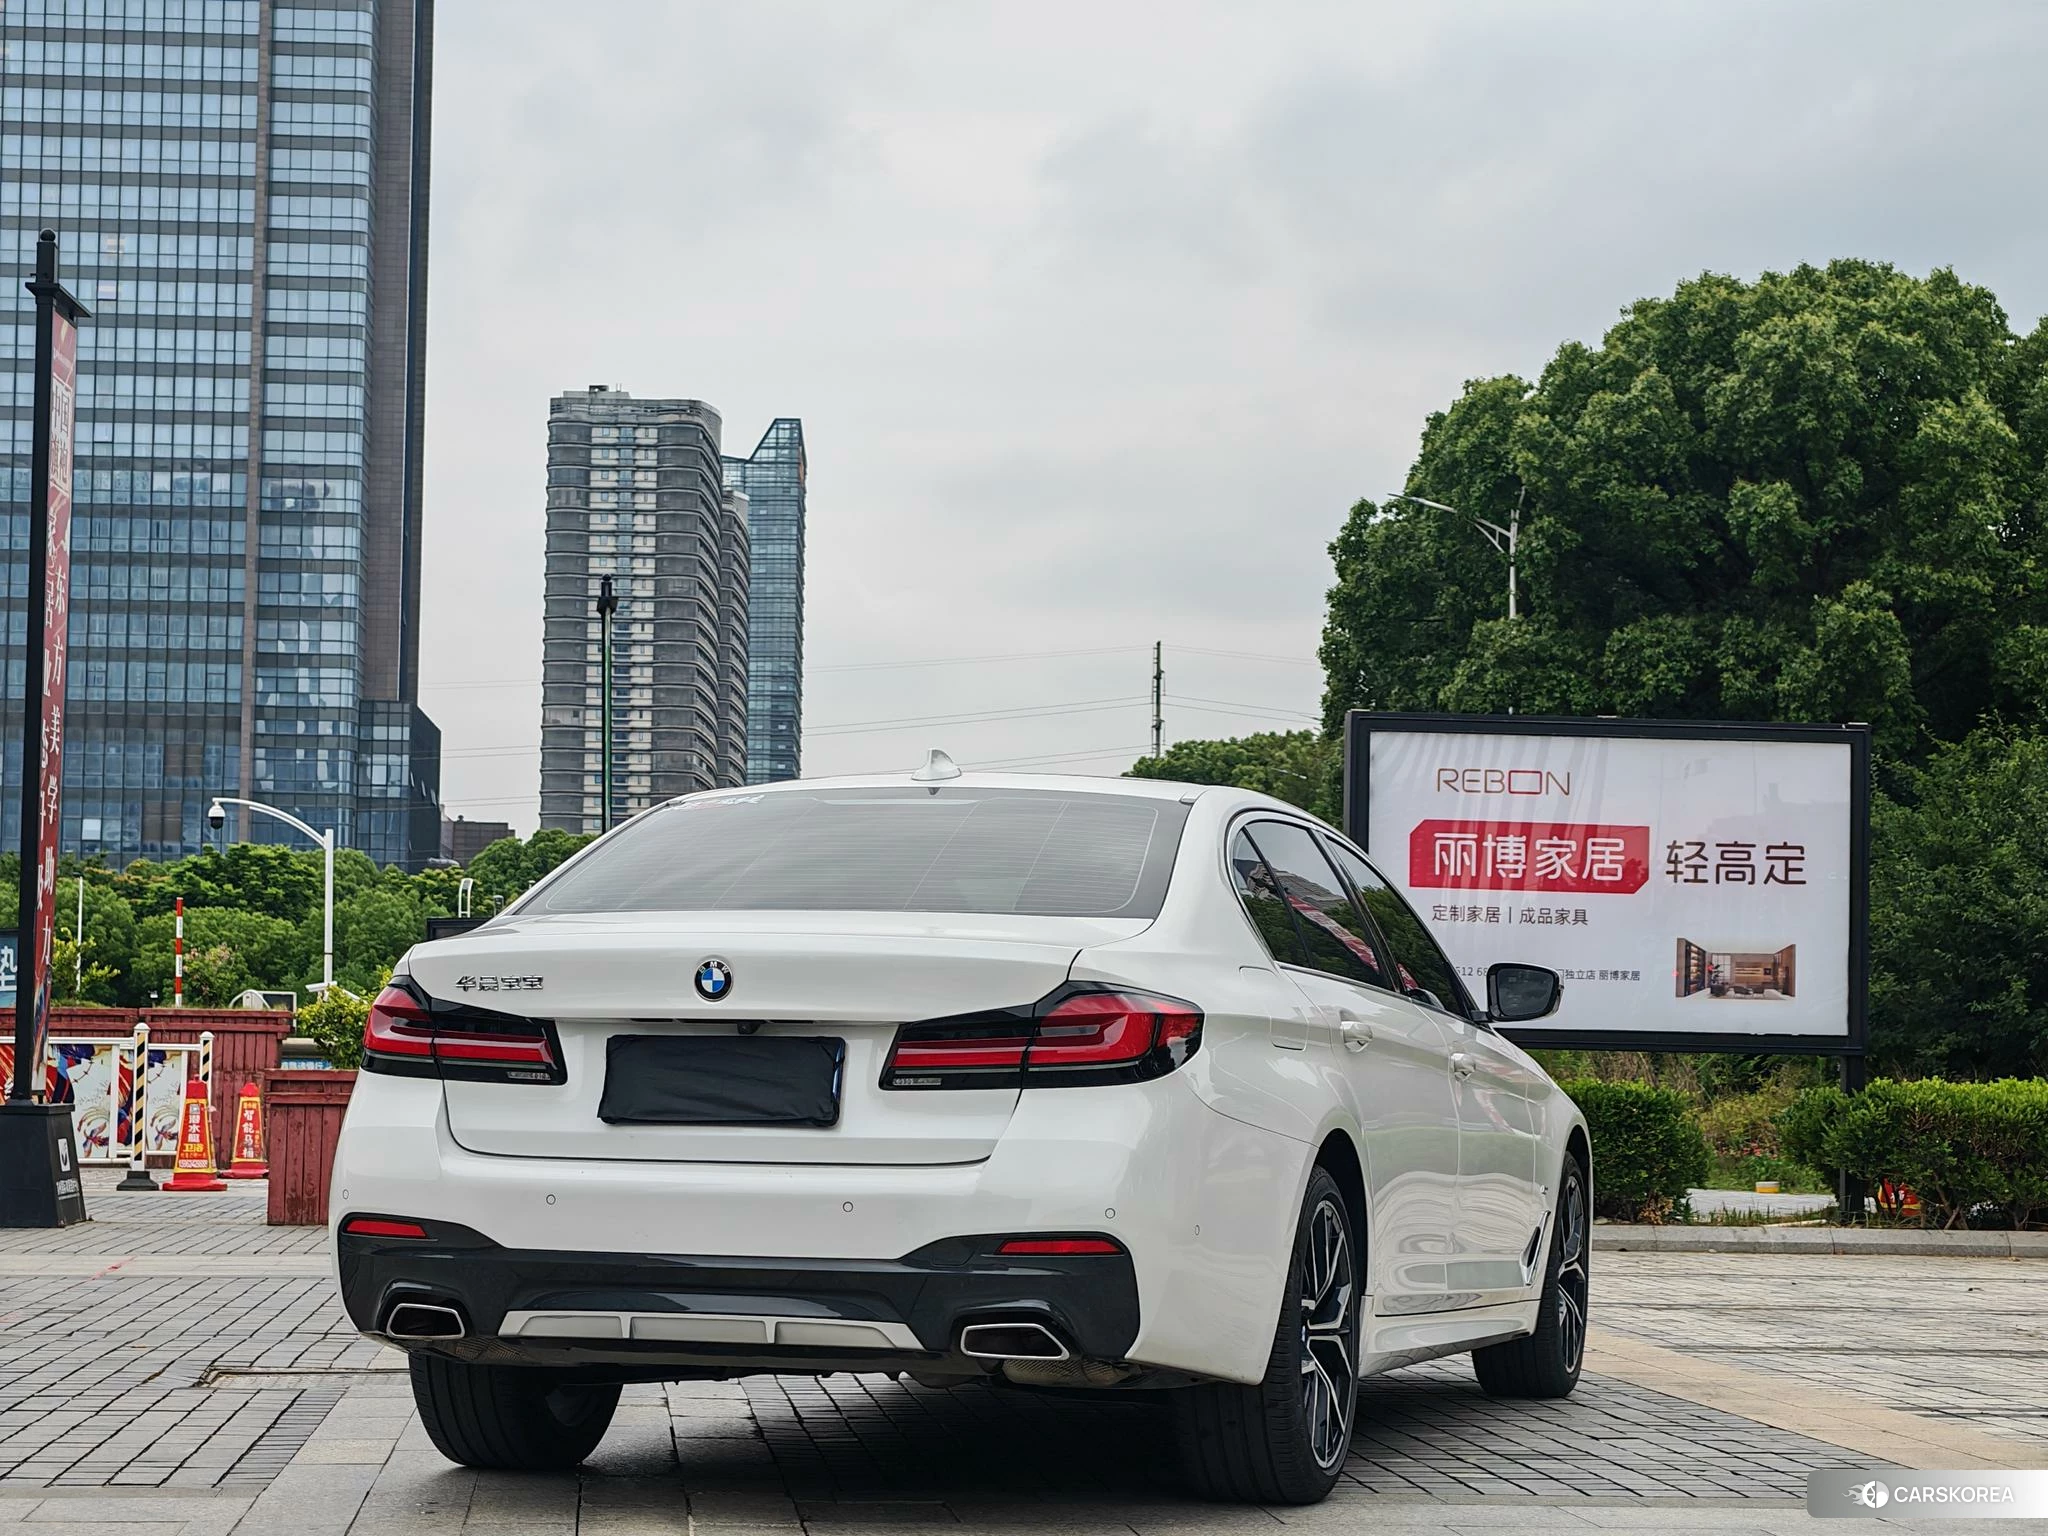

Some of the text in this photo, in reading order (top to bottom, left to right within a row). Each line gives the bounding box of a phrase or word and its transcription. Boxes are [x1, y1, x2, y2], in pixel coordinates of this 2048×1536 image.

[41, 565, 67, 966] 东方美学助力
[1437, 768, 1571, 796] REBON
[1433, 832, 1808, 886] 丽博家居 轻高定
[1431, 904, 1589, 927] 定制家居 成品家具
[1598, 969, 1641, 982] 丽博家居
